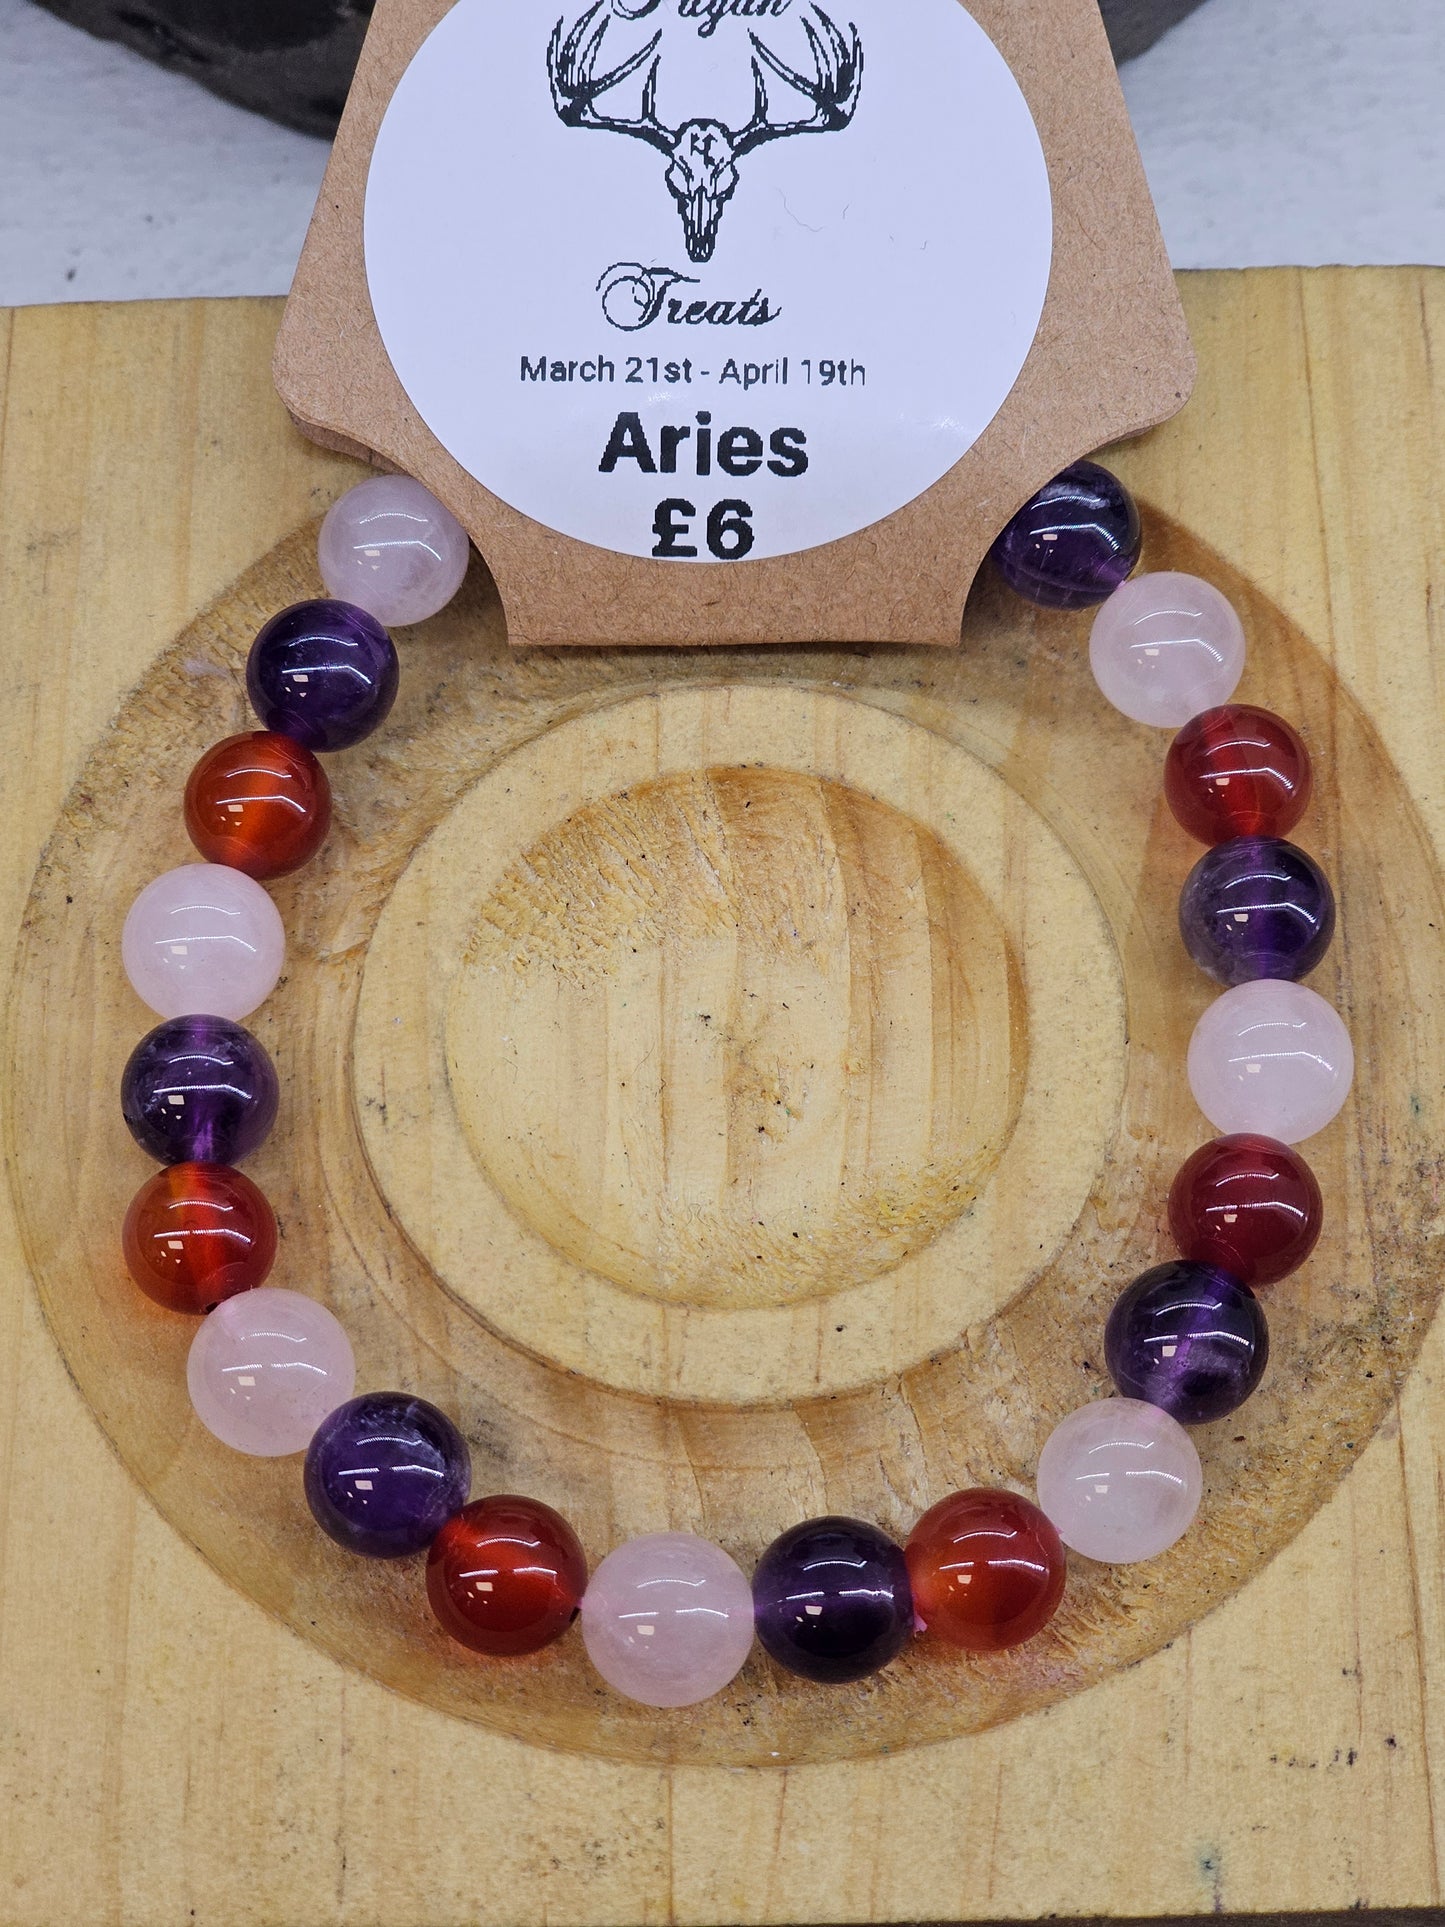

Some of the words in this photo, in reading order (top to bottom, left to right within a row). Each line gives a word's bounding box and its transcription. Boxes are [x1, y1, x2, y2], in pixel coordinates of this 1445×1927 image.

[595, 261, 783, 332] Treats
[520, 354, 615, 383] March
[624, 356, 693, 384] 21st
[718, 356, 788, 391] April
[800, 358, 866, 386] 19th
[598, 410, 809, 478] Aries
[651, 497, 755, 561] £6
